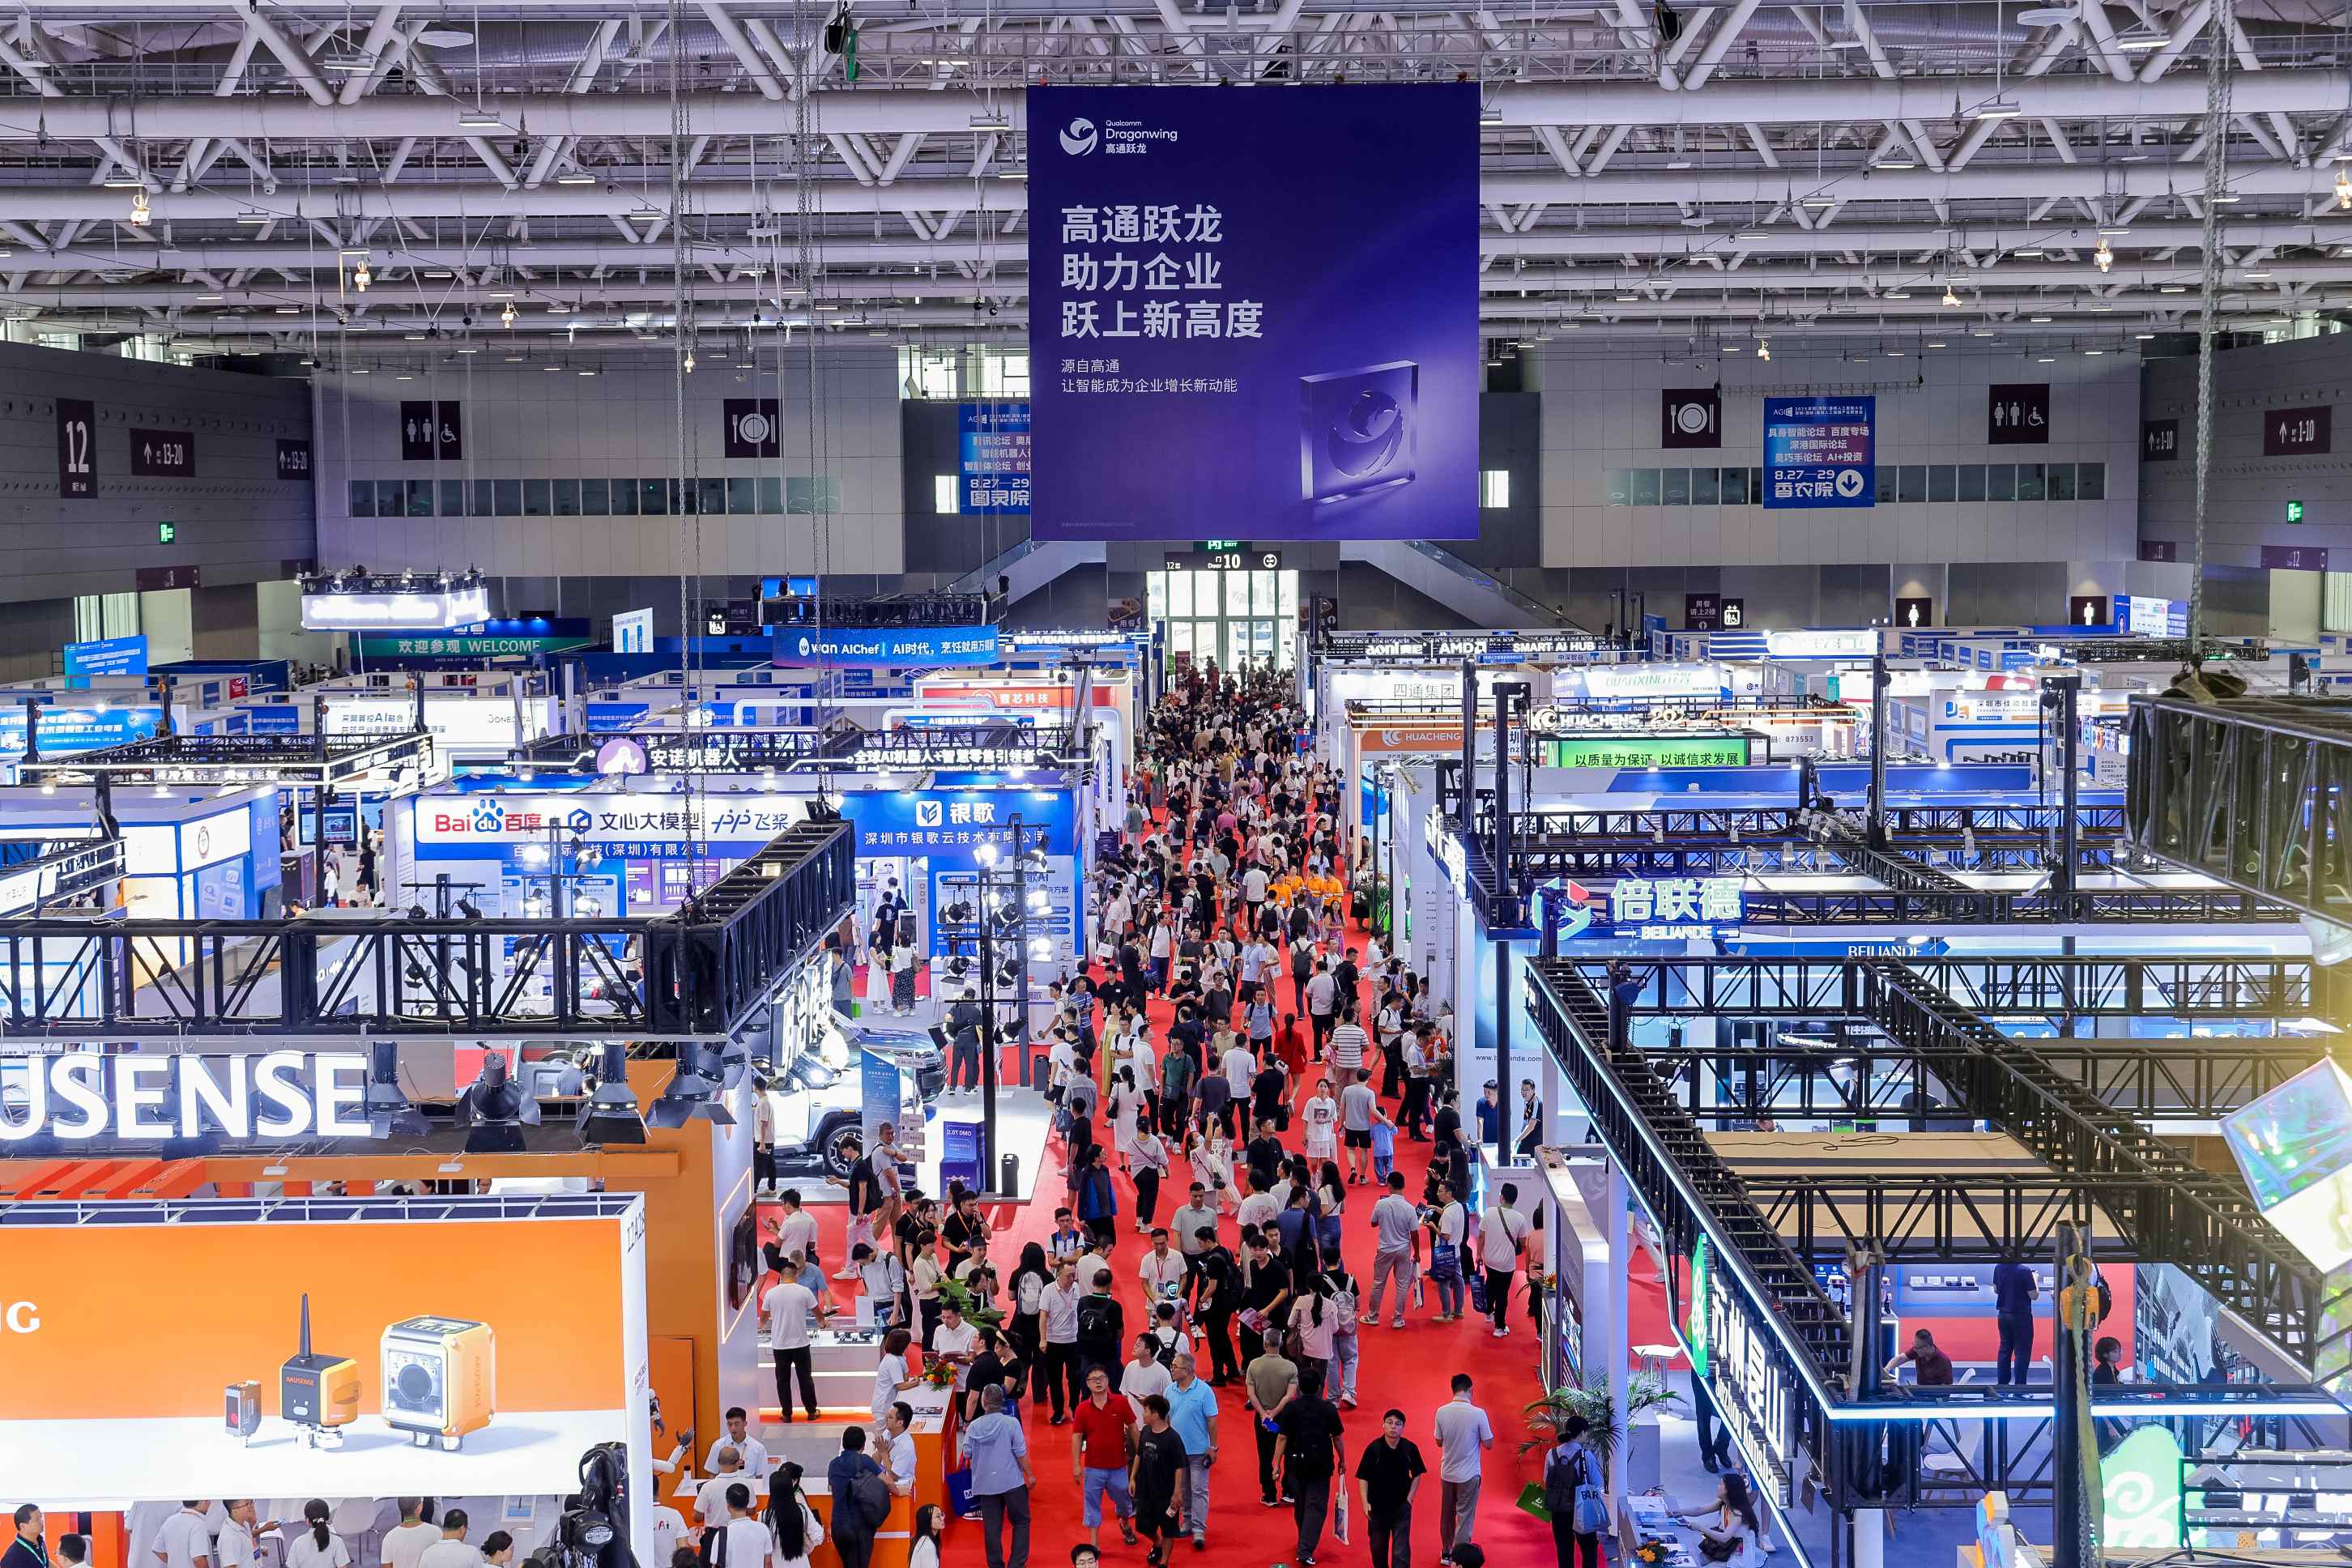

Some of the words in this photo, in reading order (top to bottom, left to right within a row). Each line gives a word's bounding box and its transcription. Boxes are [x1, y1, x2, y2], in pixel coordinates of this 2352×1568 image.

[1106, 128, 1178, 142] Dragonwing
[1106, 143, 1147, 155] 高通跃龙
[1060, 204, 1223, 244] 高通跃龙
[1060, 252, 1222, 292] 助力企业
[1060, 299, 1263, 339] 跃上新高度
[1061, 359, 1120, 373] 源自高通
[1061, 378, 1238, 394] 让智能成为企业增长新动能
[1831, 426, 1869, 437] 百度专场
[66, 420, 89, 473] 12
[163, 443, 184, 465] 13-20
[1827, 452, 1863, 462] AI+投资
[1224, 554, 1241, 569] 10
[398, 639, 461, 654] 欢迎参观
[467, 640, 541, 653] WELCOME
[841, 643, 880, 654] AIChef
[1439, 644, 1472, 654] AMD
[1512, 641, 1553, 652] SMART
[1570, 641, 1595, 651] HUB
[1394, 683, 1455, 699] 四通集团
[1562, 714, 1639, 726] HUACHENG
[1405, 732, 1460, 741] HUACHENG
[650, 748, 739, 767] 安诺机器人
[1575, 754, 1653, 766] 以质量为保证
[1660, 752, 1739, 765] 以诚信求发展
[754, 812, 789, 831] 飞桨
[949, 803, 995, 824] 银歌
[505, 813, 542, 833] 百度
[599, 812, 700, 832] 文心大模型
[1611, 878, 1742, 922] 倍联德
[1640, 925, 1714, 940] BEILIANDE
[0, 1050, 373, 1140] USENSE
[1742, 1411, 1780, 1510] Kunshan
